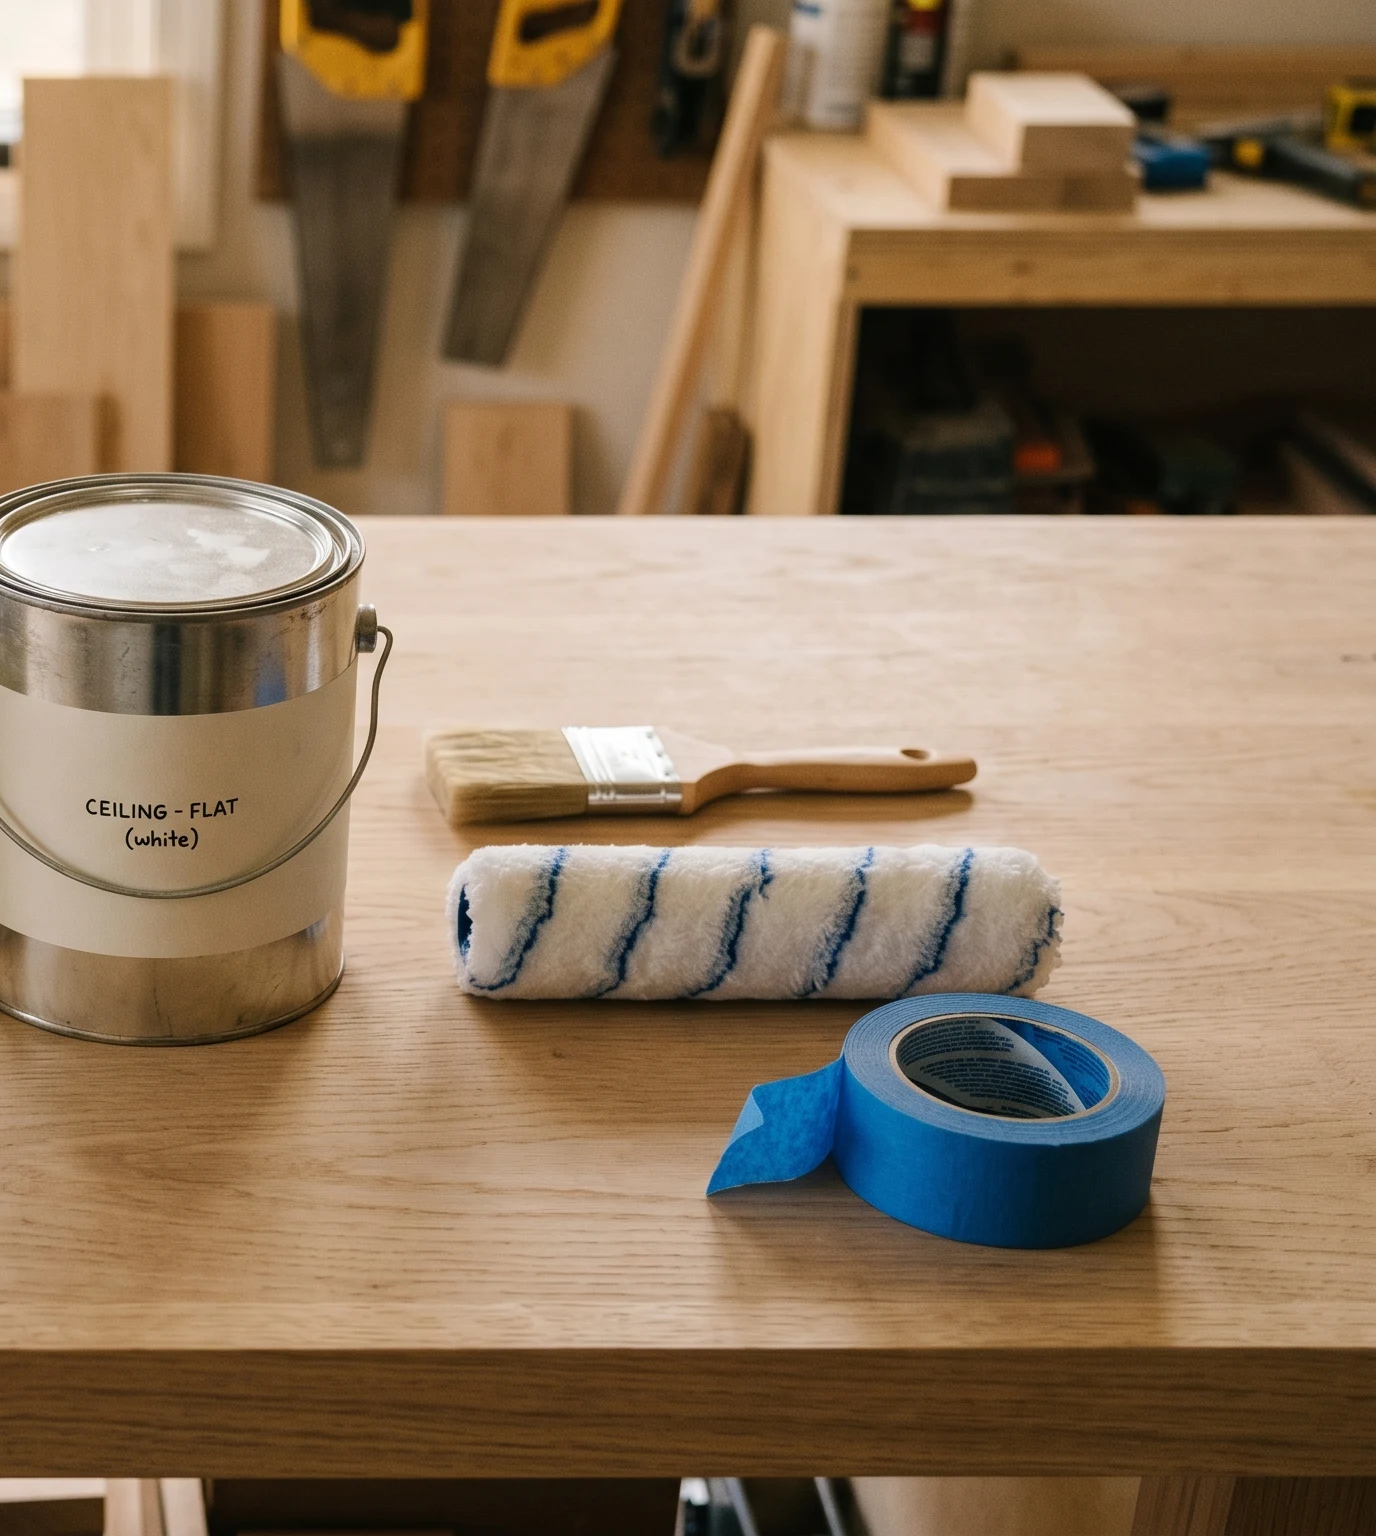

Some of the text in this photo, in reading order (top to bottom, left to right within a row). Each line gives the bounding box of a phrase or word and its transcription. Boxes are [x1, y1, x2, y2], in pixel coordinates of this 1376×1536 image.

[85, 798, 168, 820] CEILING
[189, 797, 239, 819] FLAT
[124, 826, 199, 850] (white)
